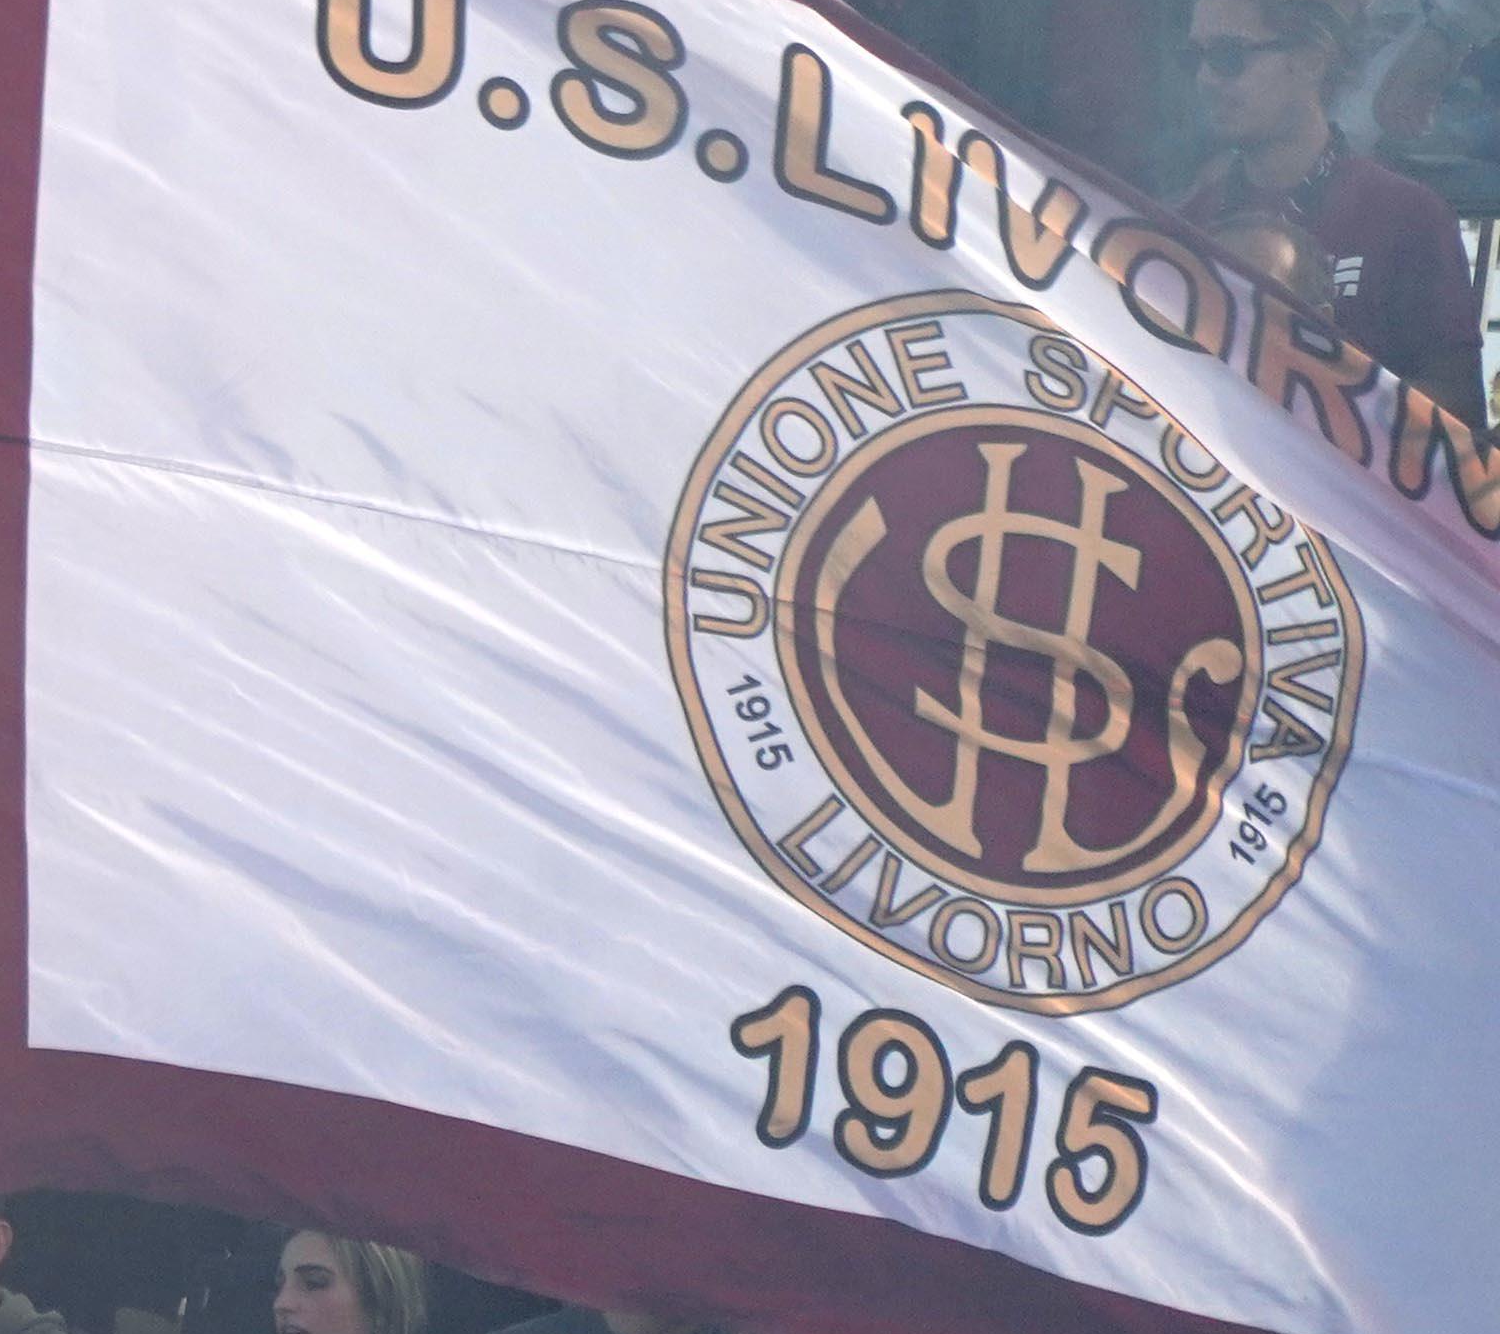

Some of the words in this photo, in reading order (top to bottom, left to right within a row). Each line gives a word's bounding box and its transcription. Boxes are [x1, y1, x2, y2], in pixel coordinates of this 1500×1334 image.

[692, 319, 968, 642] UNIONE
[725, 674, 793, 772] 1915
[1229, 782, 1288, 867] 1915
[779, 796, 1209, 991] LIVORNO
[731, 985, 1161, 1235] 1915
